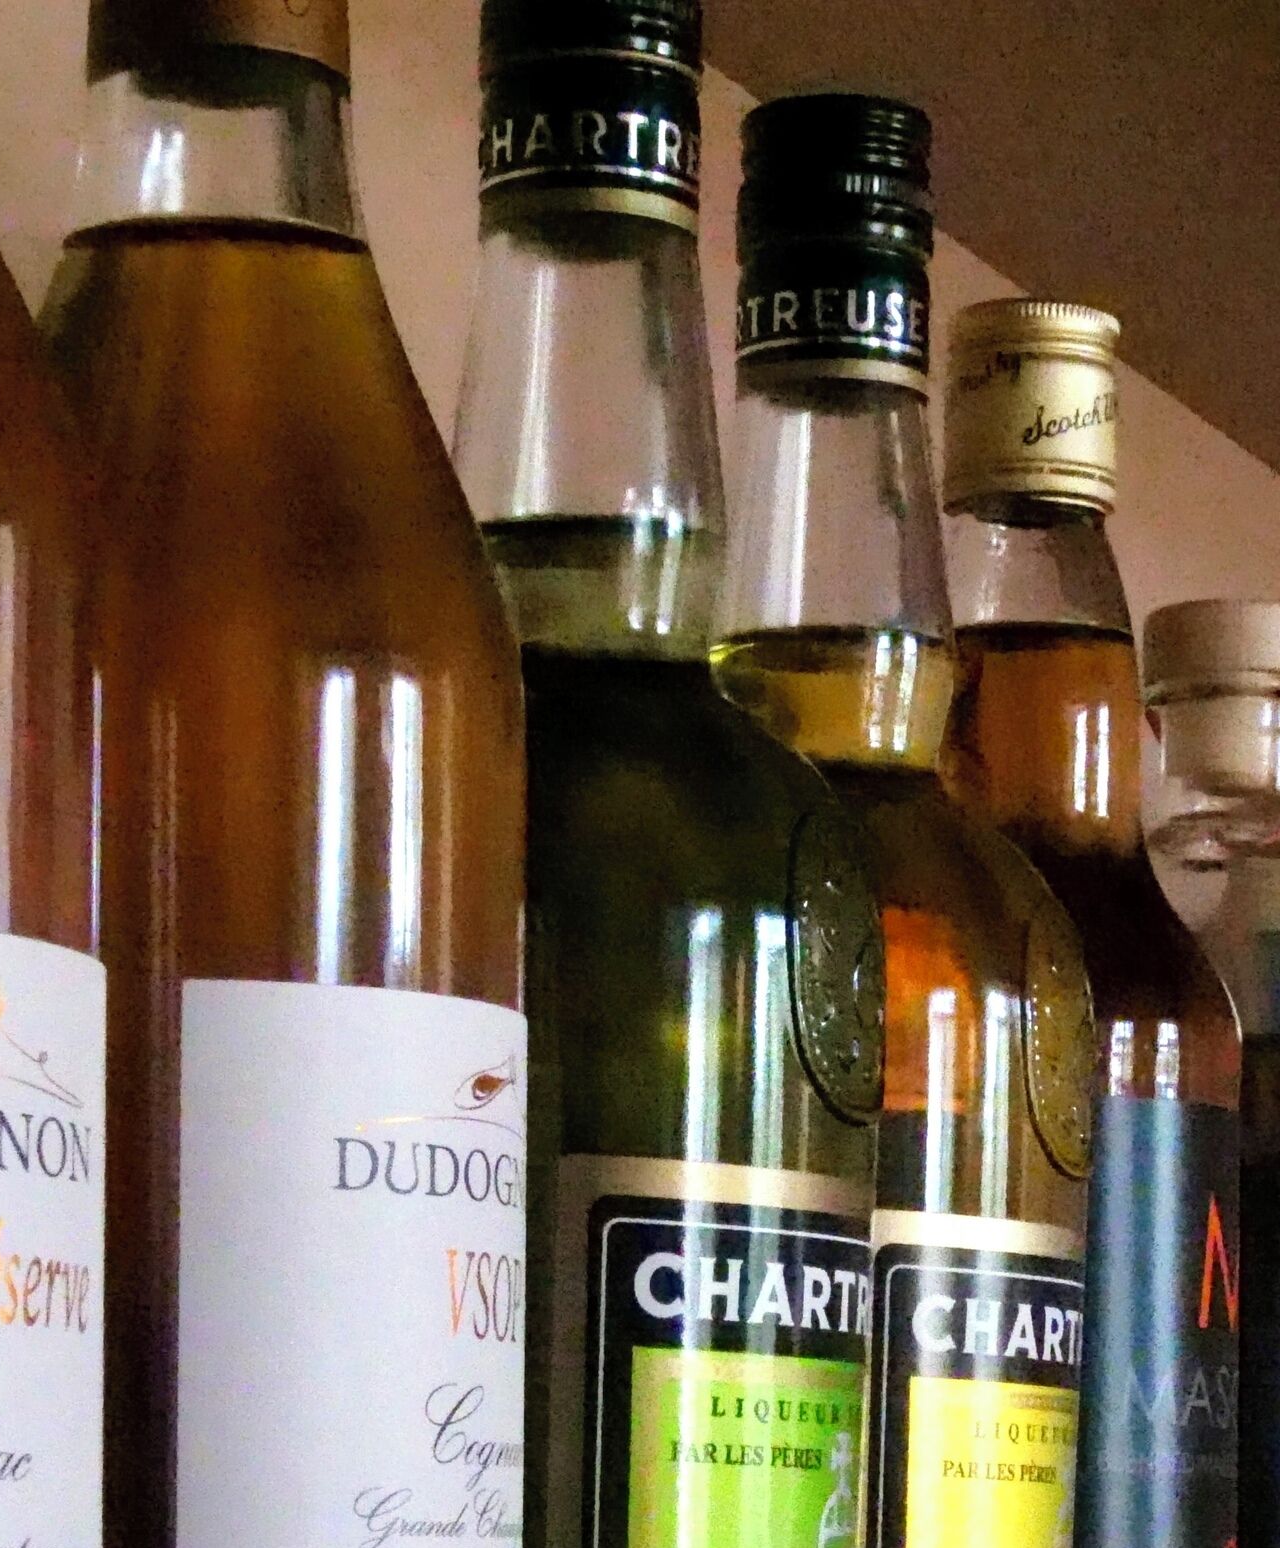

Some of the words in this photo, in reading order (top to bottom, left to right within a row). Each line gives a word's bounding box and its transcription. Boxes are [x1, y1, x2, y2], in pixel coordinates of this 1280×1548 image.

[480, 110, 701, 178] HARTR
[737, 287, 924, 345] TREUSE
[1022, 395, 1102, 446] Scotch
[333, 1136, 519, 1209] DUDOG
[671, 1440, 718, 1465] PAR
[725, 1442, 765, 1467] LES
[943, 1459, 979, 1479] PAR
[985, 1461, 1016, 1482] LES
